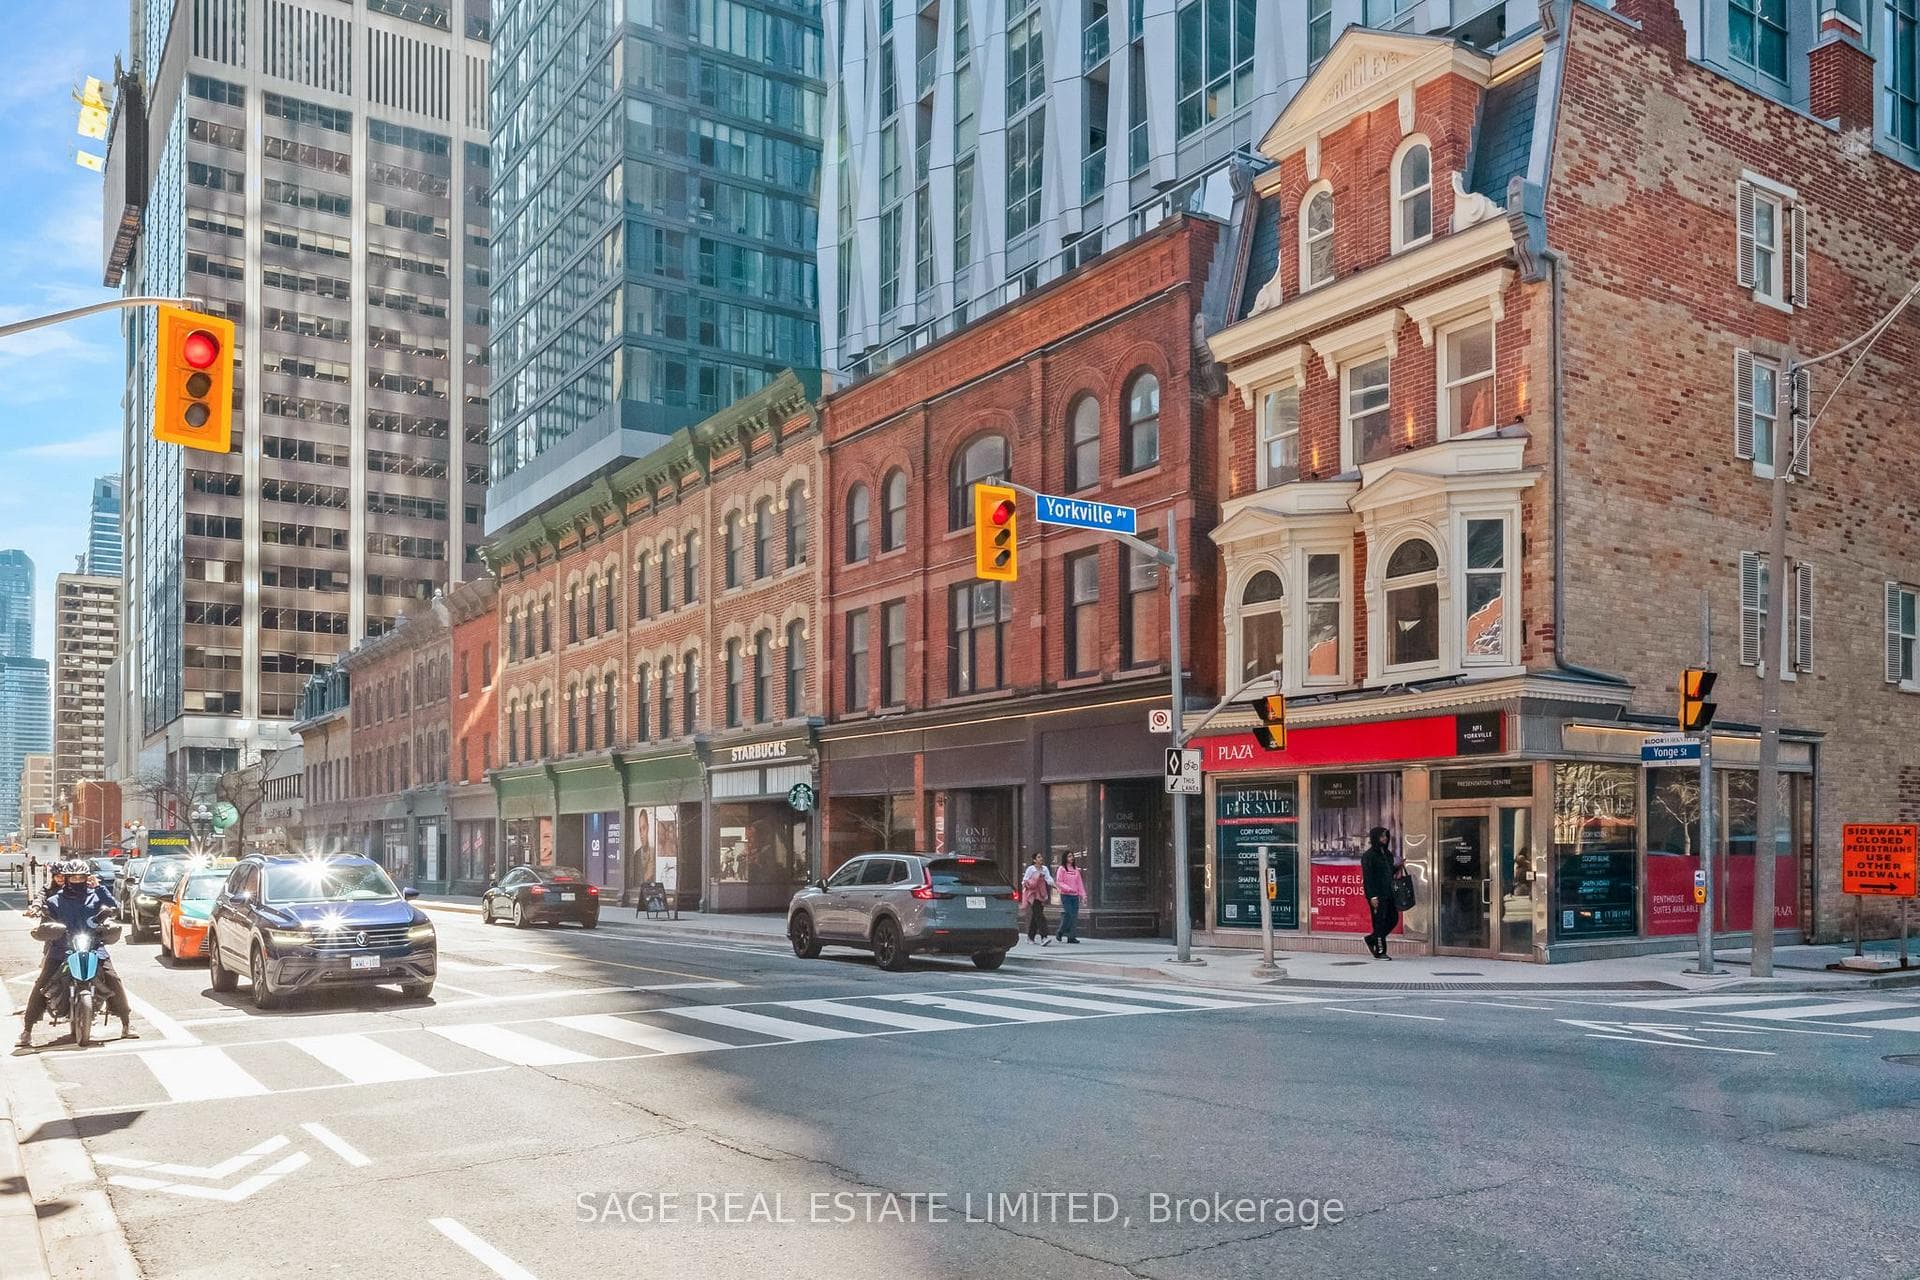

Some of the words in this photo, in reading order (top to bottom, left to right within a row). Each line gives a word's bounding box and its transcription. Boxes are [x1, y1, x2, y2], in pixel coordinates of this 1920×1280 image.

[1045, 497, 1113, 524] Yorkville
[1116, 509, 1127, 519] Av
[1464, 731, 1493, 740] YORKVILLE
[731, 741, 787, 762] STARBUCKS
[1218, 745, 1254, 761] PLAZA
[1653, 747, 1679, 759] Yonge
[1680, 748, 1688, 756] St
[1238, 789, 1281, 802] RETAIL
[1226, 802, 1251, 816] FR
[1255, 800, 1290, 814] SALE
[1847, 828, 1912, 836] SIDEWALK
[1856, 836, 1904, 845] CLOSED
[1846, 845, 1912, 853] PEDESTRIANS
[1866, 853, 1892, 861] USE
[1856, 862, 1902, 870] OTHER
[1317, 875, 1338, 883] NEW
[1847, 870, 1912, 880] SIDEWALK
[1317, 887, 1365, 896] PENTHOUS
[1317, 898, 1346, 906] SUITES
[1653, 895, 1684, 904] PENTHOUSE
[1653, 905, 1671, 914] SUITES
[1672, 905, 1699, 913] AVAILABLE
